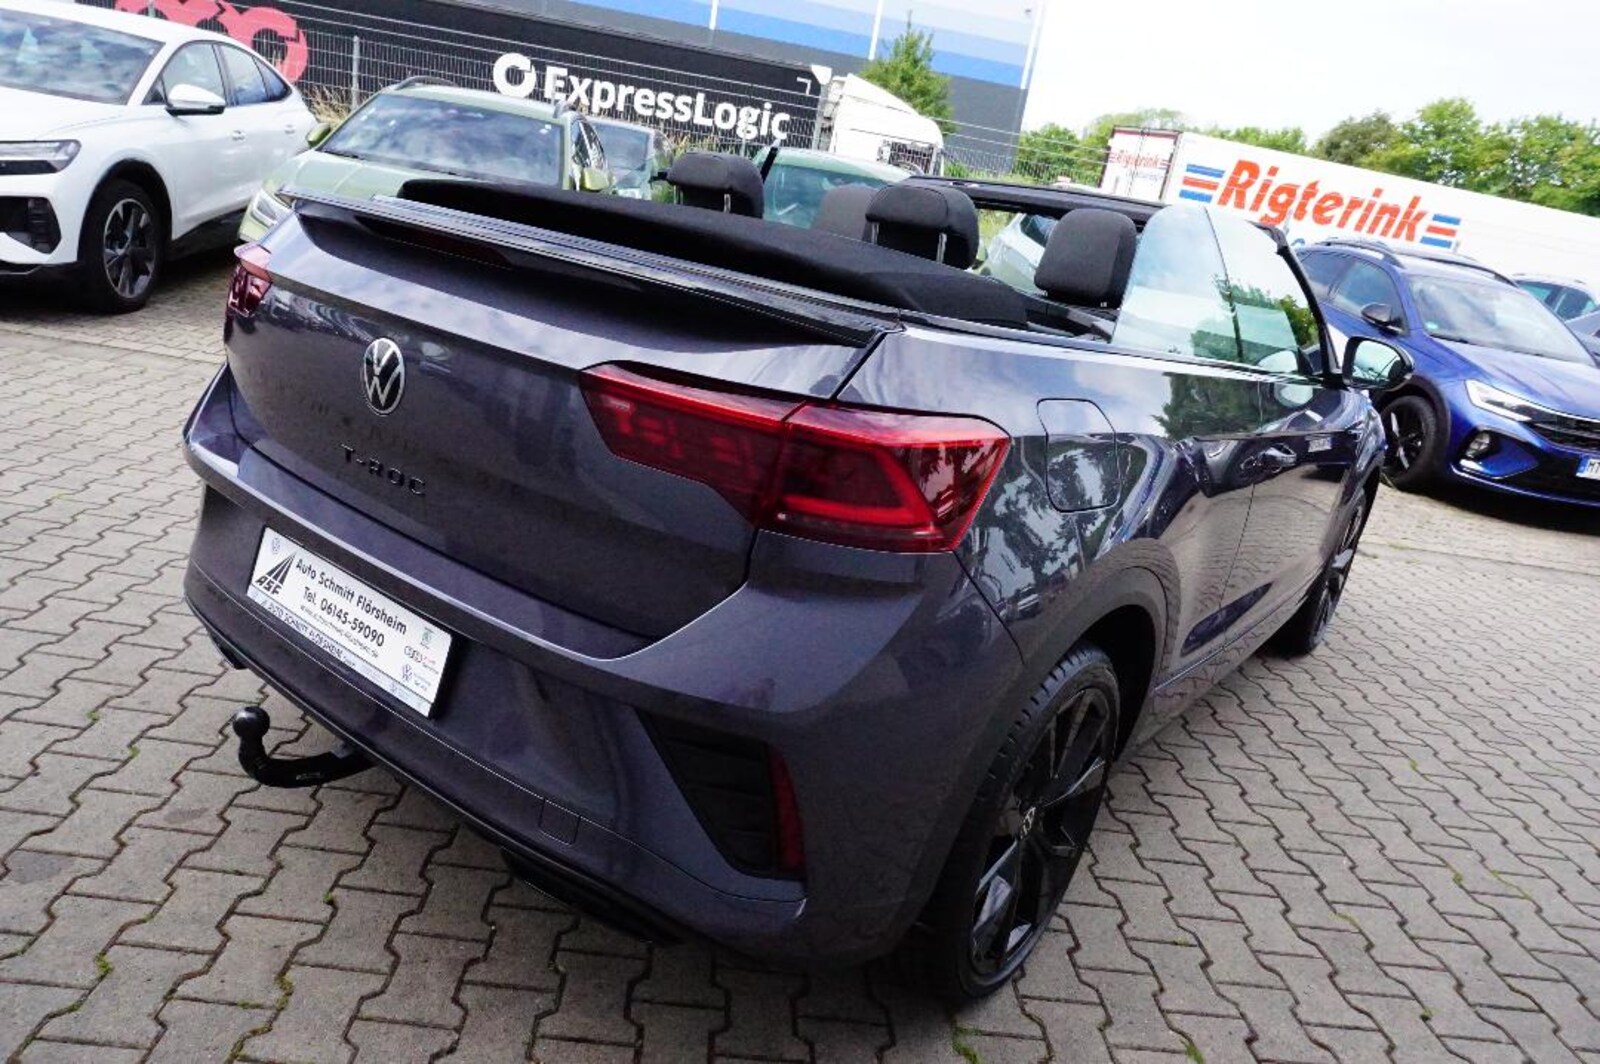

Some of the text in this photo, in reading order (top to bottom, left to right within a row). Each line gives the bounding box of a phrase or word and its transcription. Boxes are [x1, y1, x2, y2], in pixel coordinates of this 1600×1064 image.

[543, 65, 790, 140] ExpressLogic
[1217, 159, 1429, 242] Rigterink
[341, 444, 425, 496] T-ROC
[255, 575, 283, 595] ASF
[295, 559, 316, 579] Auto
[318, 571, 355, 603] Schmitt
[356, 595, 407, 635] Flörsheim
[304, 586, 317, 605] Tel.
[321, 598, 385, 647] 06145-59090
